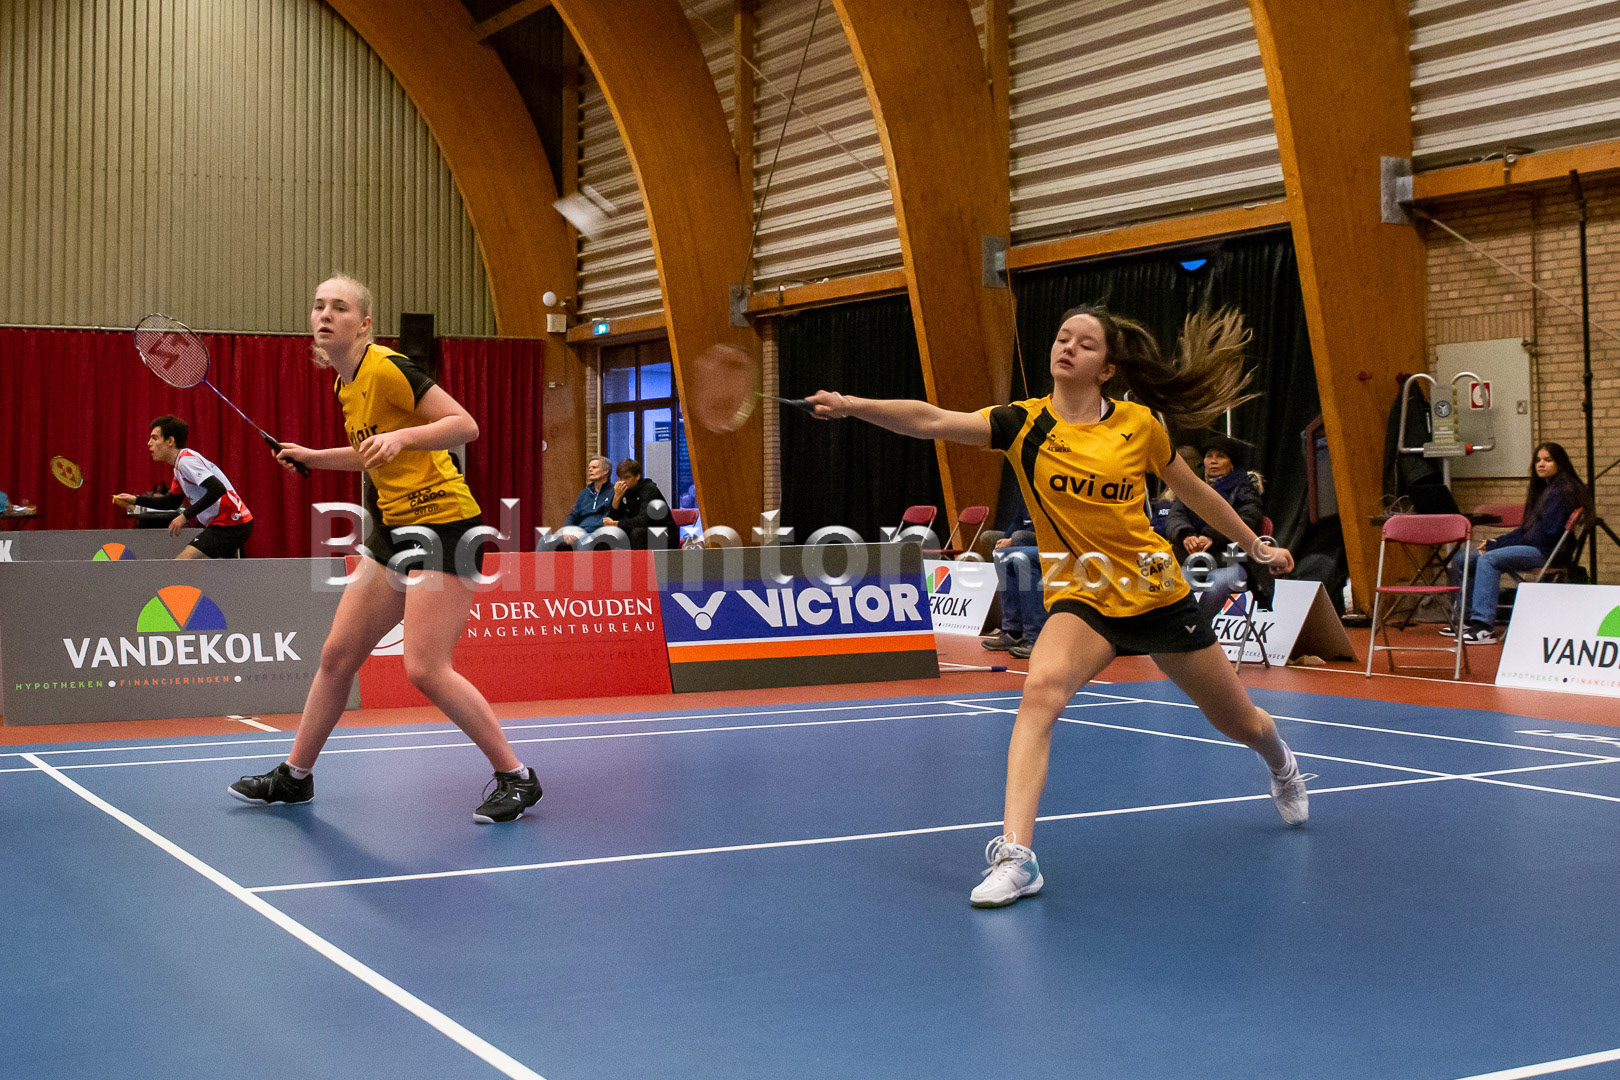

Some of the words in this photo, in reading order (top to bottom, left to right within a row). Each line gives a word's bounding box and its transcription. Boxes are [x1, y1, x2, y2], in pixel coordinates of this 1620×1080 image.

[1049, 474, 1095, 497] avi
[410, 490, 446, 507] CARGO
[1141, 556, 1172, 577] CARGO
[490, 601, 541, 620] DER
[542, 597, 654, 618] WOUDEN
[736, 584, 923, 628] VICTOR
[467, 621, 656, 639] NAGEMENTBUREAU
[62, 631, 301, 669] VANDEKOLK
[1543, 637, 1620, 668] VAND
[15, 680, 103, 691] HYPOTHEKEN
[120, 675, 230, 687] FINANCIERINGEN
[1501, 671, 1560, 682] HYPOTHEKEN
